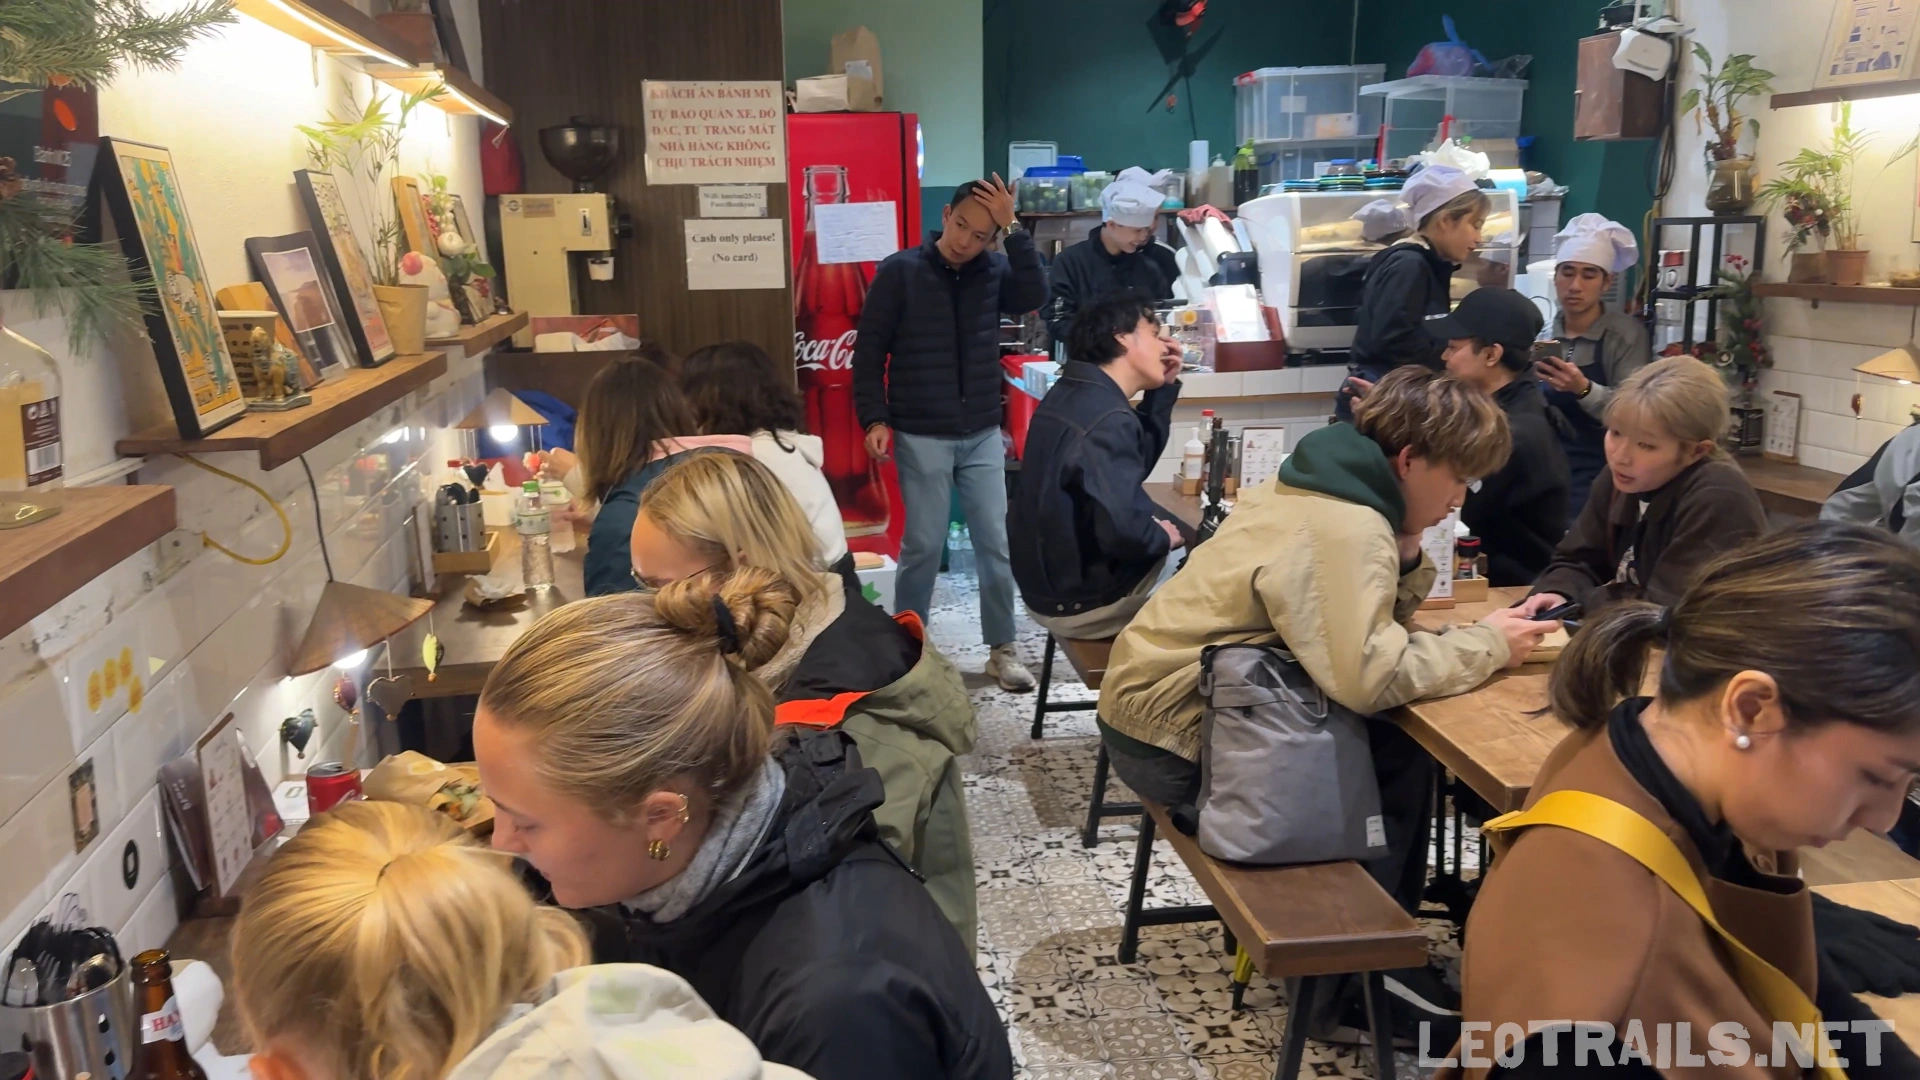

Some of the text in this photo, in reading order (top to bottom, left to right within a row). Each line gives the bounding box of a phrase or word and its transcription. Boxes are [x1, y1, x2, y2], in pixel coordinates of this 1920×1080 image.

[717, 86, 751, 99] BÁNH
[704, 125, 746, 136] TRANG
[727, 138, 771, 151] KHÔNG
[692, 233, 776, 244] Cash only please!
[712, 253, 758, 263] (No card)
